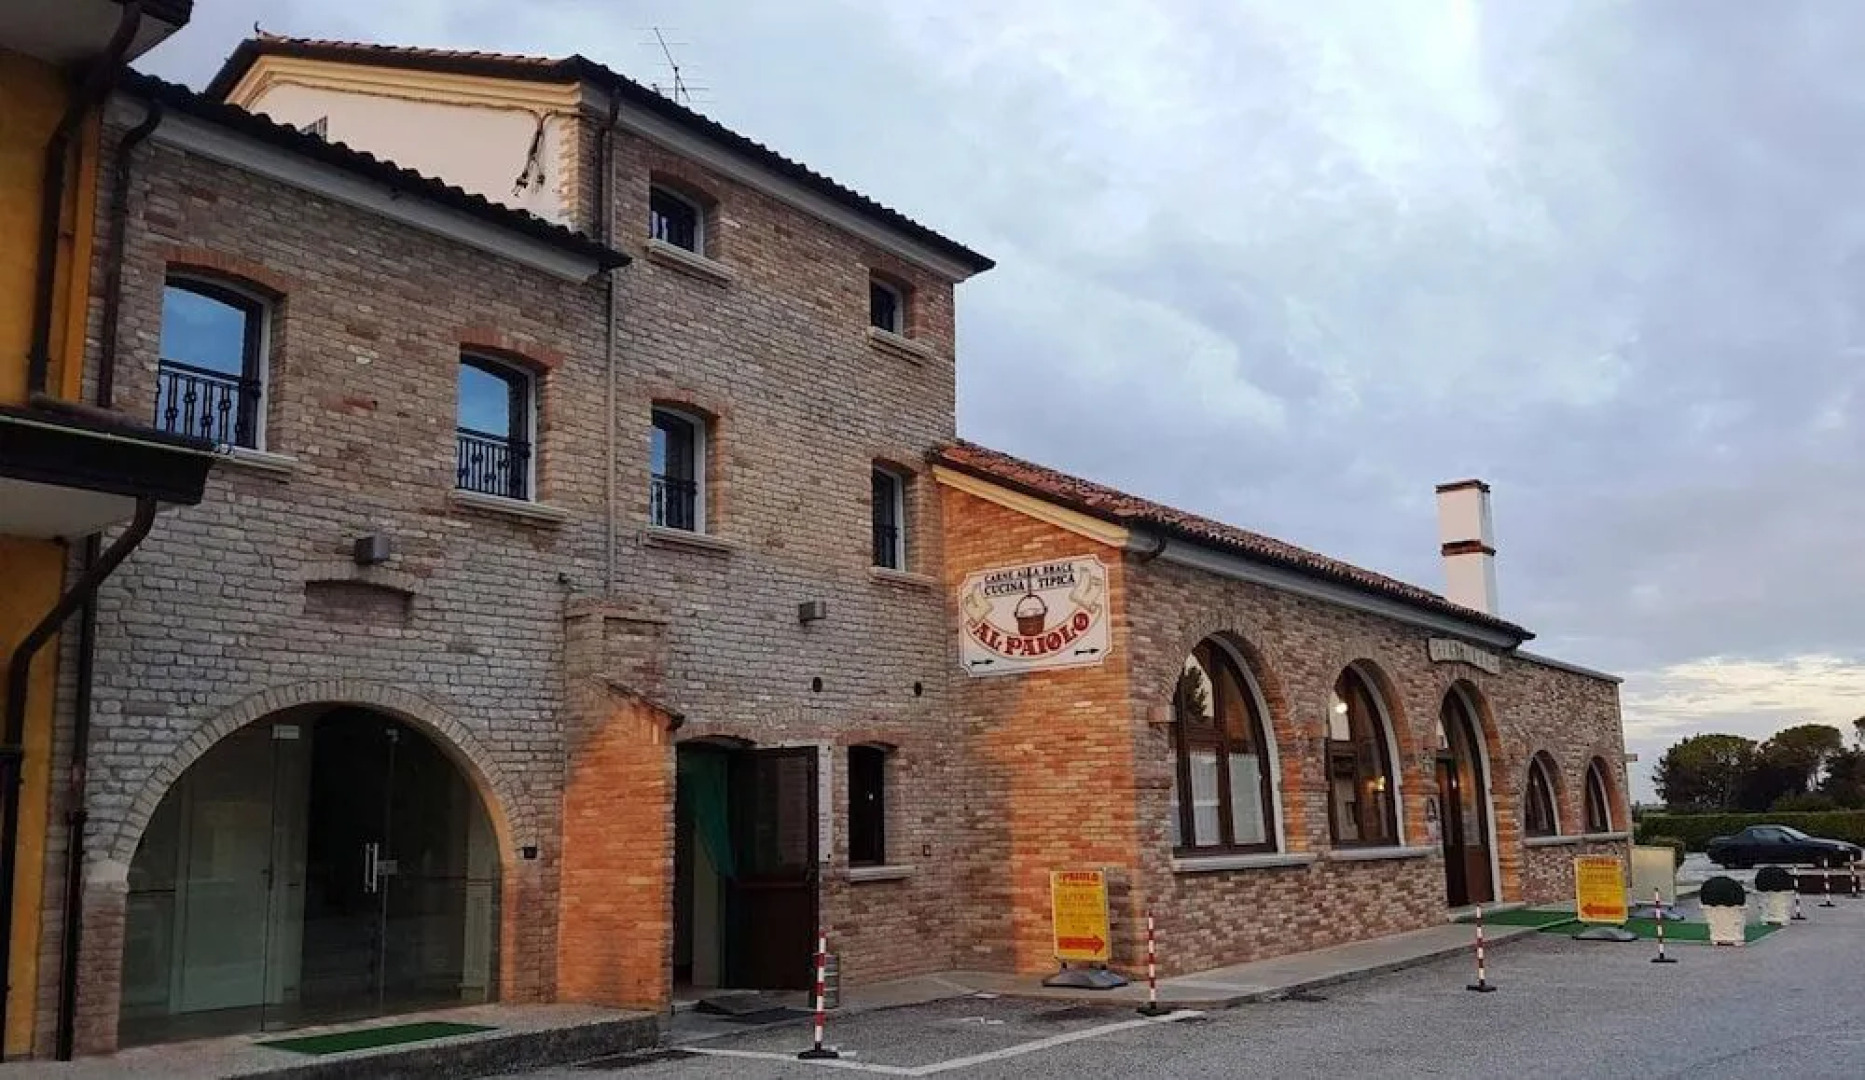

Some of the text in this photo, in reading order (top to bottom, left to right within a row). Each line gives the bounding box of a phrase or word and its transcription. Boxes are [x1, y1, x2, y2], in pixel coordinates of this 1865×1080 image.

[984, 570, 1014, 584] CARNE
[984, 573, 1075, 596] CUCINA TIPICA
[973, 611, 1090, 656] AL PAIOLO
